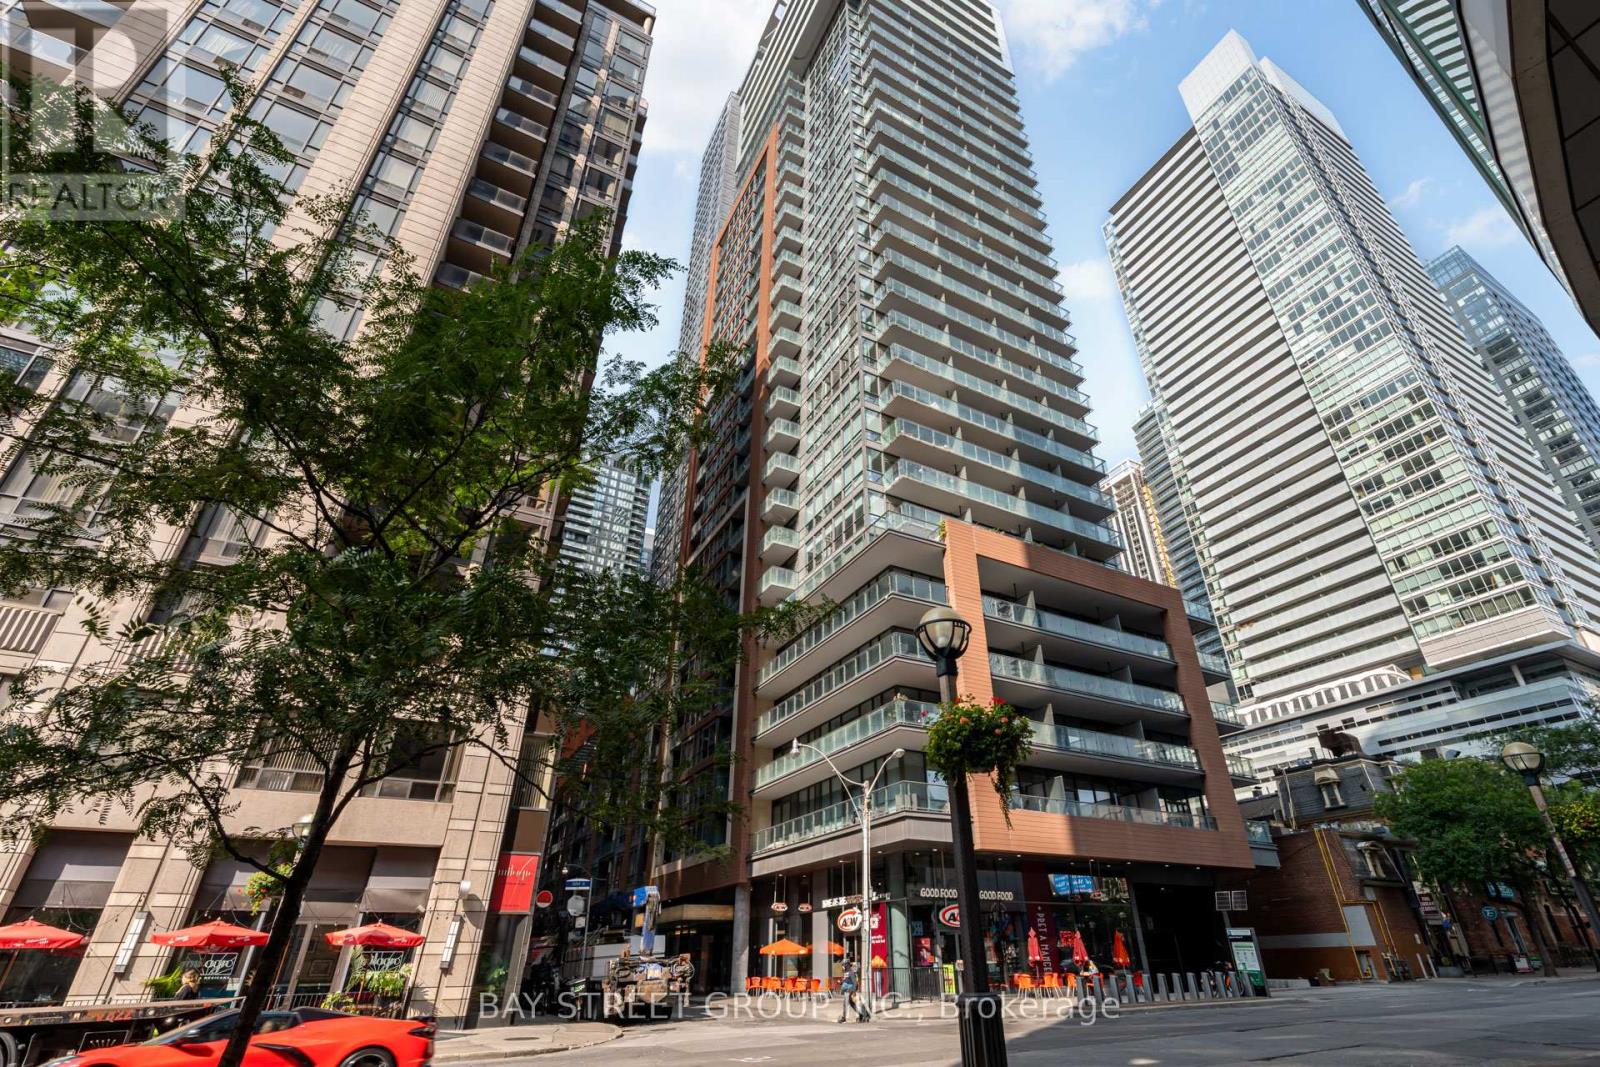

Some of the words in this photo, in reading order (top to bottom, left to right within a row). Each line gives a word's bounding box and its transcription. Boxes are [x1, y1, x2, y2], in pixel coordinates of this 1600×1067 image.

[920, 887, 939, 898] GOOD
[940, 888, 958, 899] FOOD
[979, 890, 997, 900] GOOD
[997, 891, 1014, 901] FOOD
